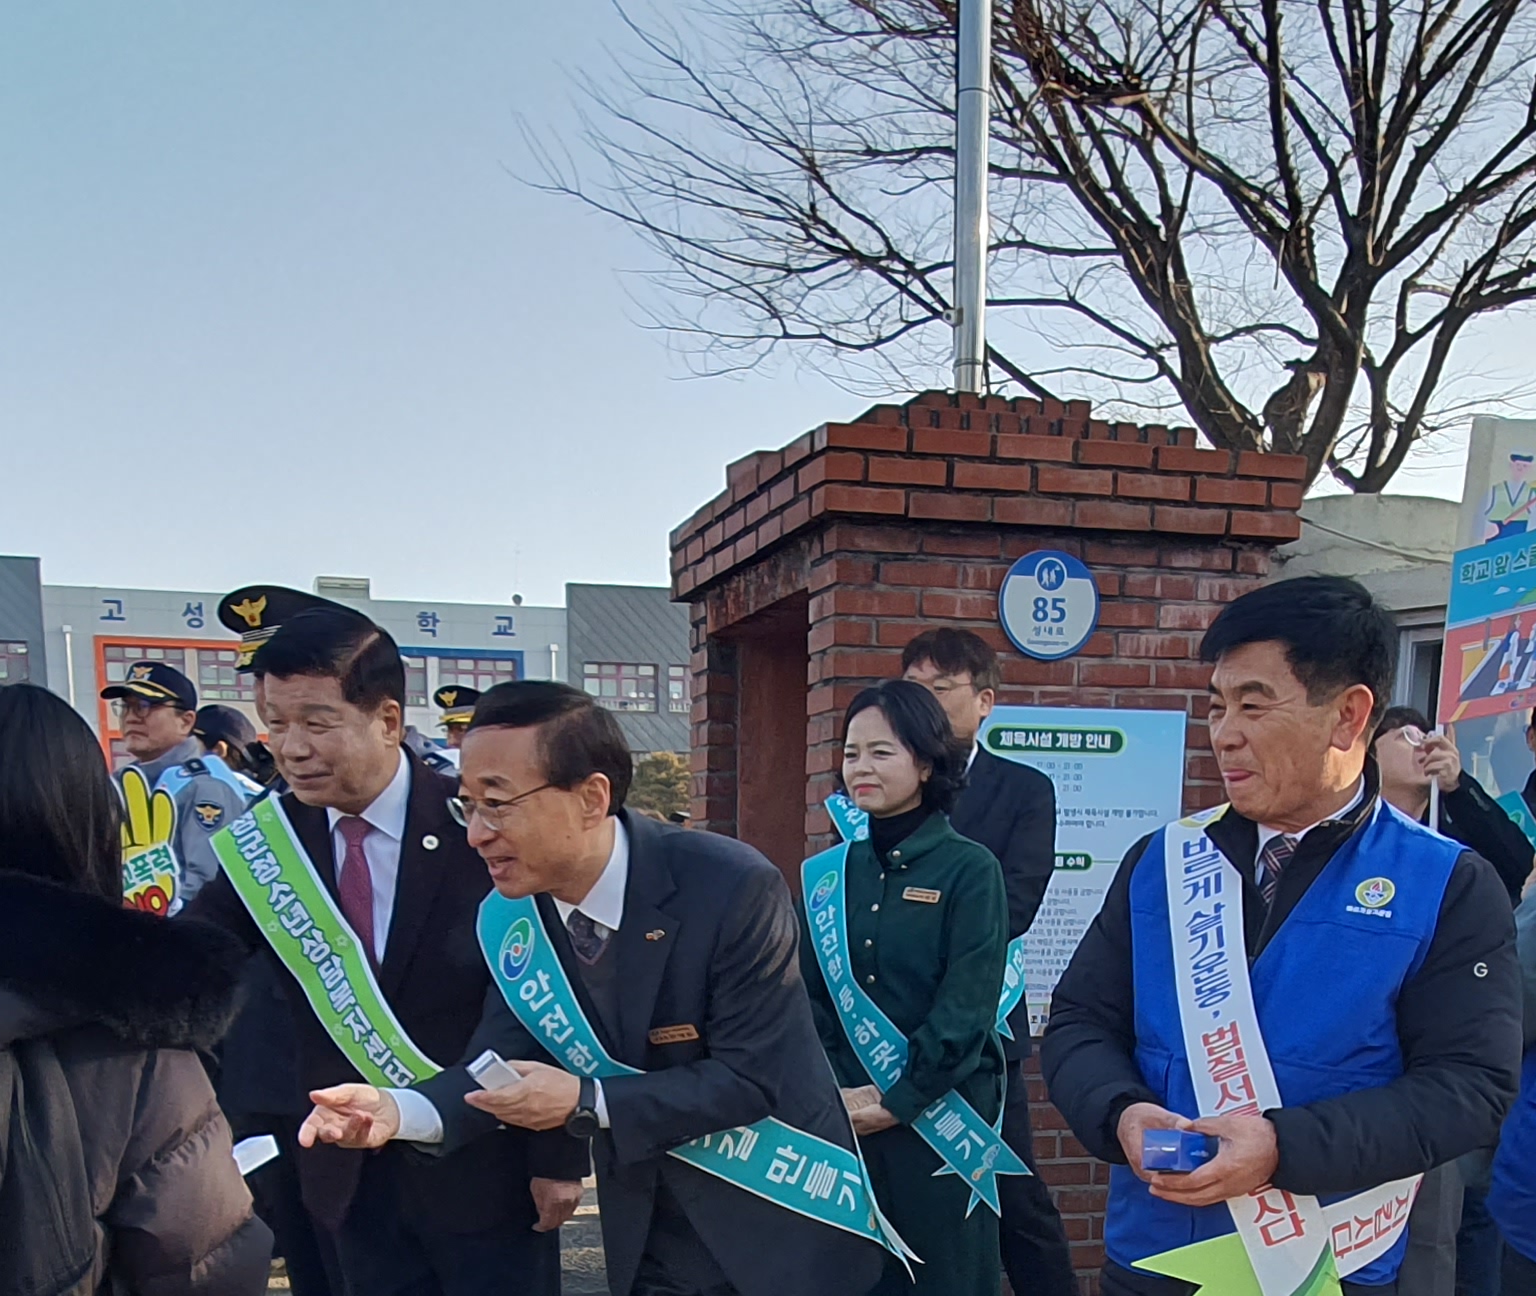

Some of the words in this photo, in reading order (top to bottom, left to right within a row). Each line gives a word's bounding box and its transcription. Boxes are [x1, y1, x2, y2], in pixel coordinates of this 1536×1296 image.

[1460, 557, 1490, 584] 학교
[1494, 555, 1511, 574] 앞
[1032, 597, 1066, 623] 85
[999, 731, 1052, 748] 체육시설
[1056, 732, 1082, 748] 개방
[1086, 733, 1111, 749] 안내
[815, 904, 844, 983] 안전한
[1473, 962, 1489, 978] G
[519, 969, 600, 1075] 안전한
[766, 1145, 862, 1212] 만들기
